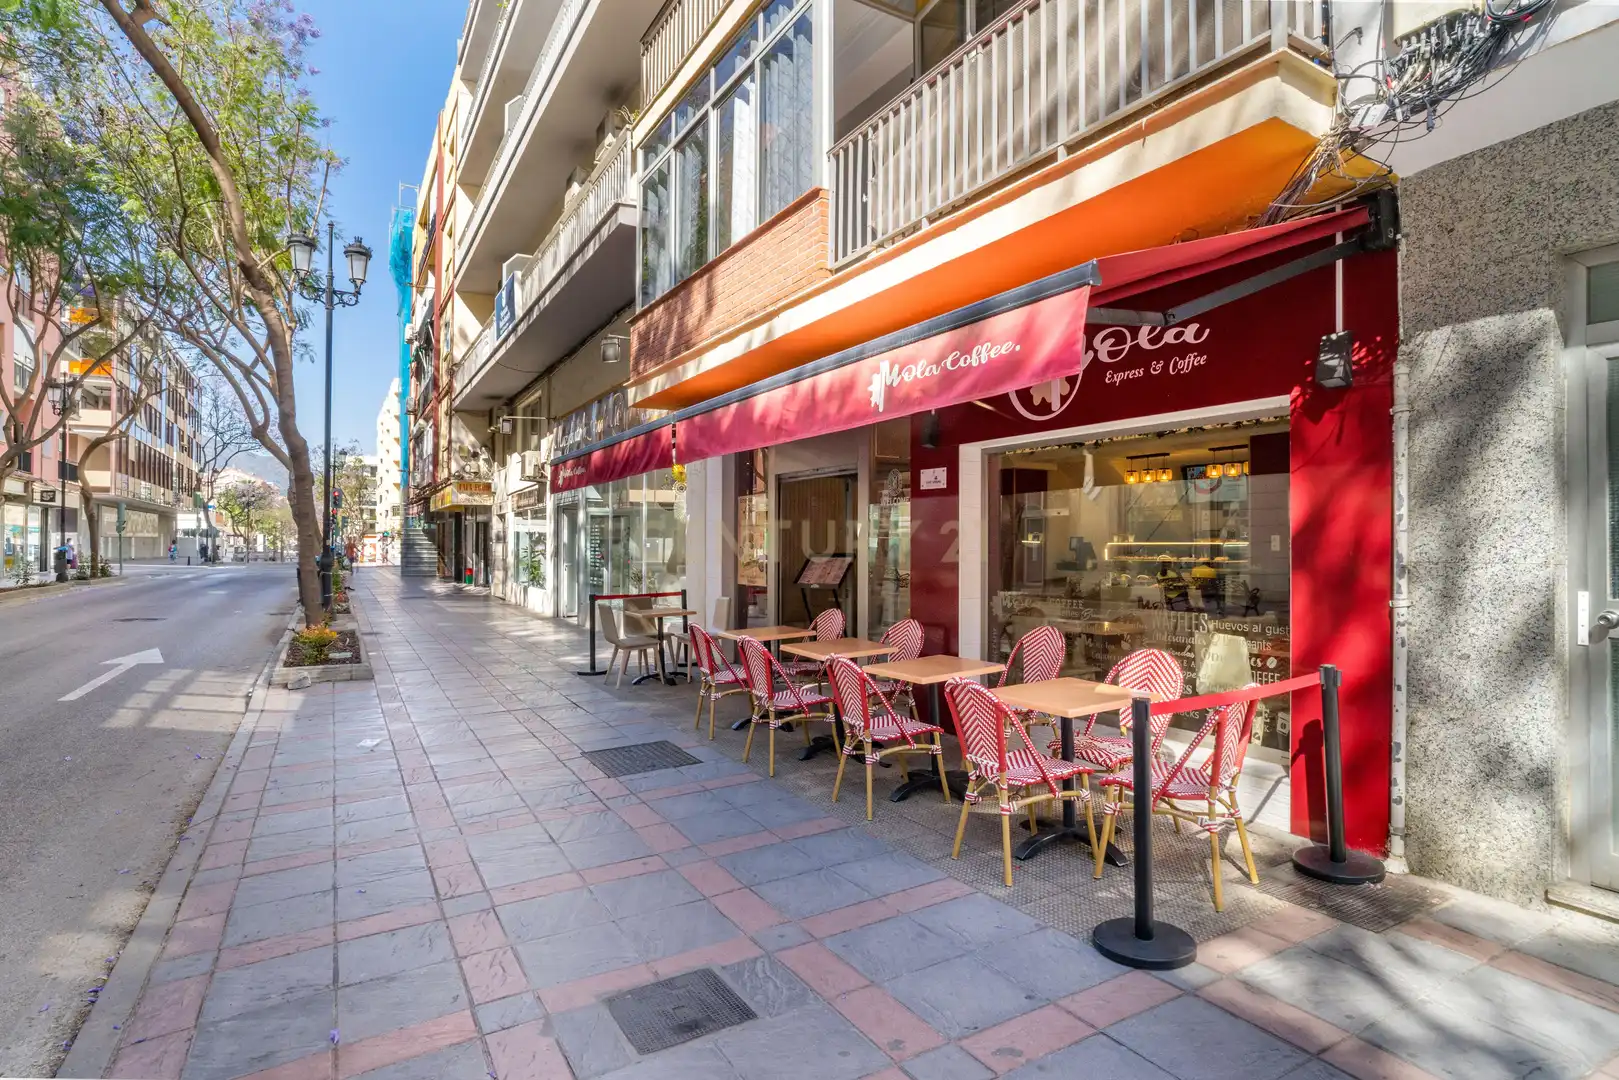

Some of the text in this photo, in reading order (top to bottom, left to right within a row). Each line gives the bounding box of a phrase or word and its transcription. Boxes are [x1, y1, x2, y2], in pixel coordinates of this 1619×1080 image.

[1105, 352, 1207, 386] Express & Coffee
[880, 497, 910, 506] WELCOME
[1152, 609, 1209, 633] WAFFLES
[1211, 620, 1249, 632] Huevos
[1252, 624, 1262, 633] al
